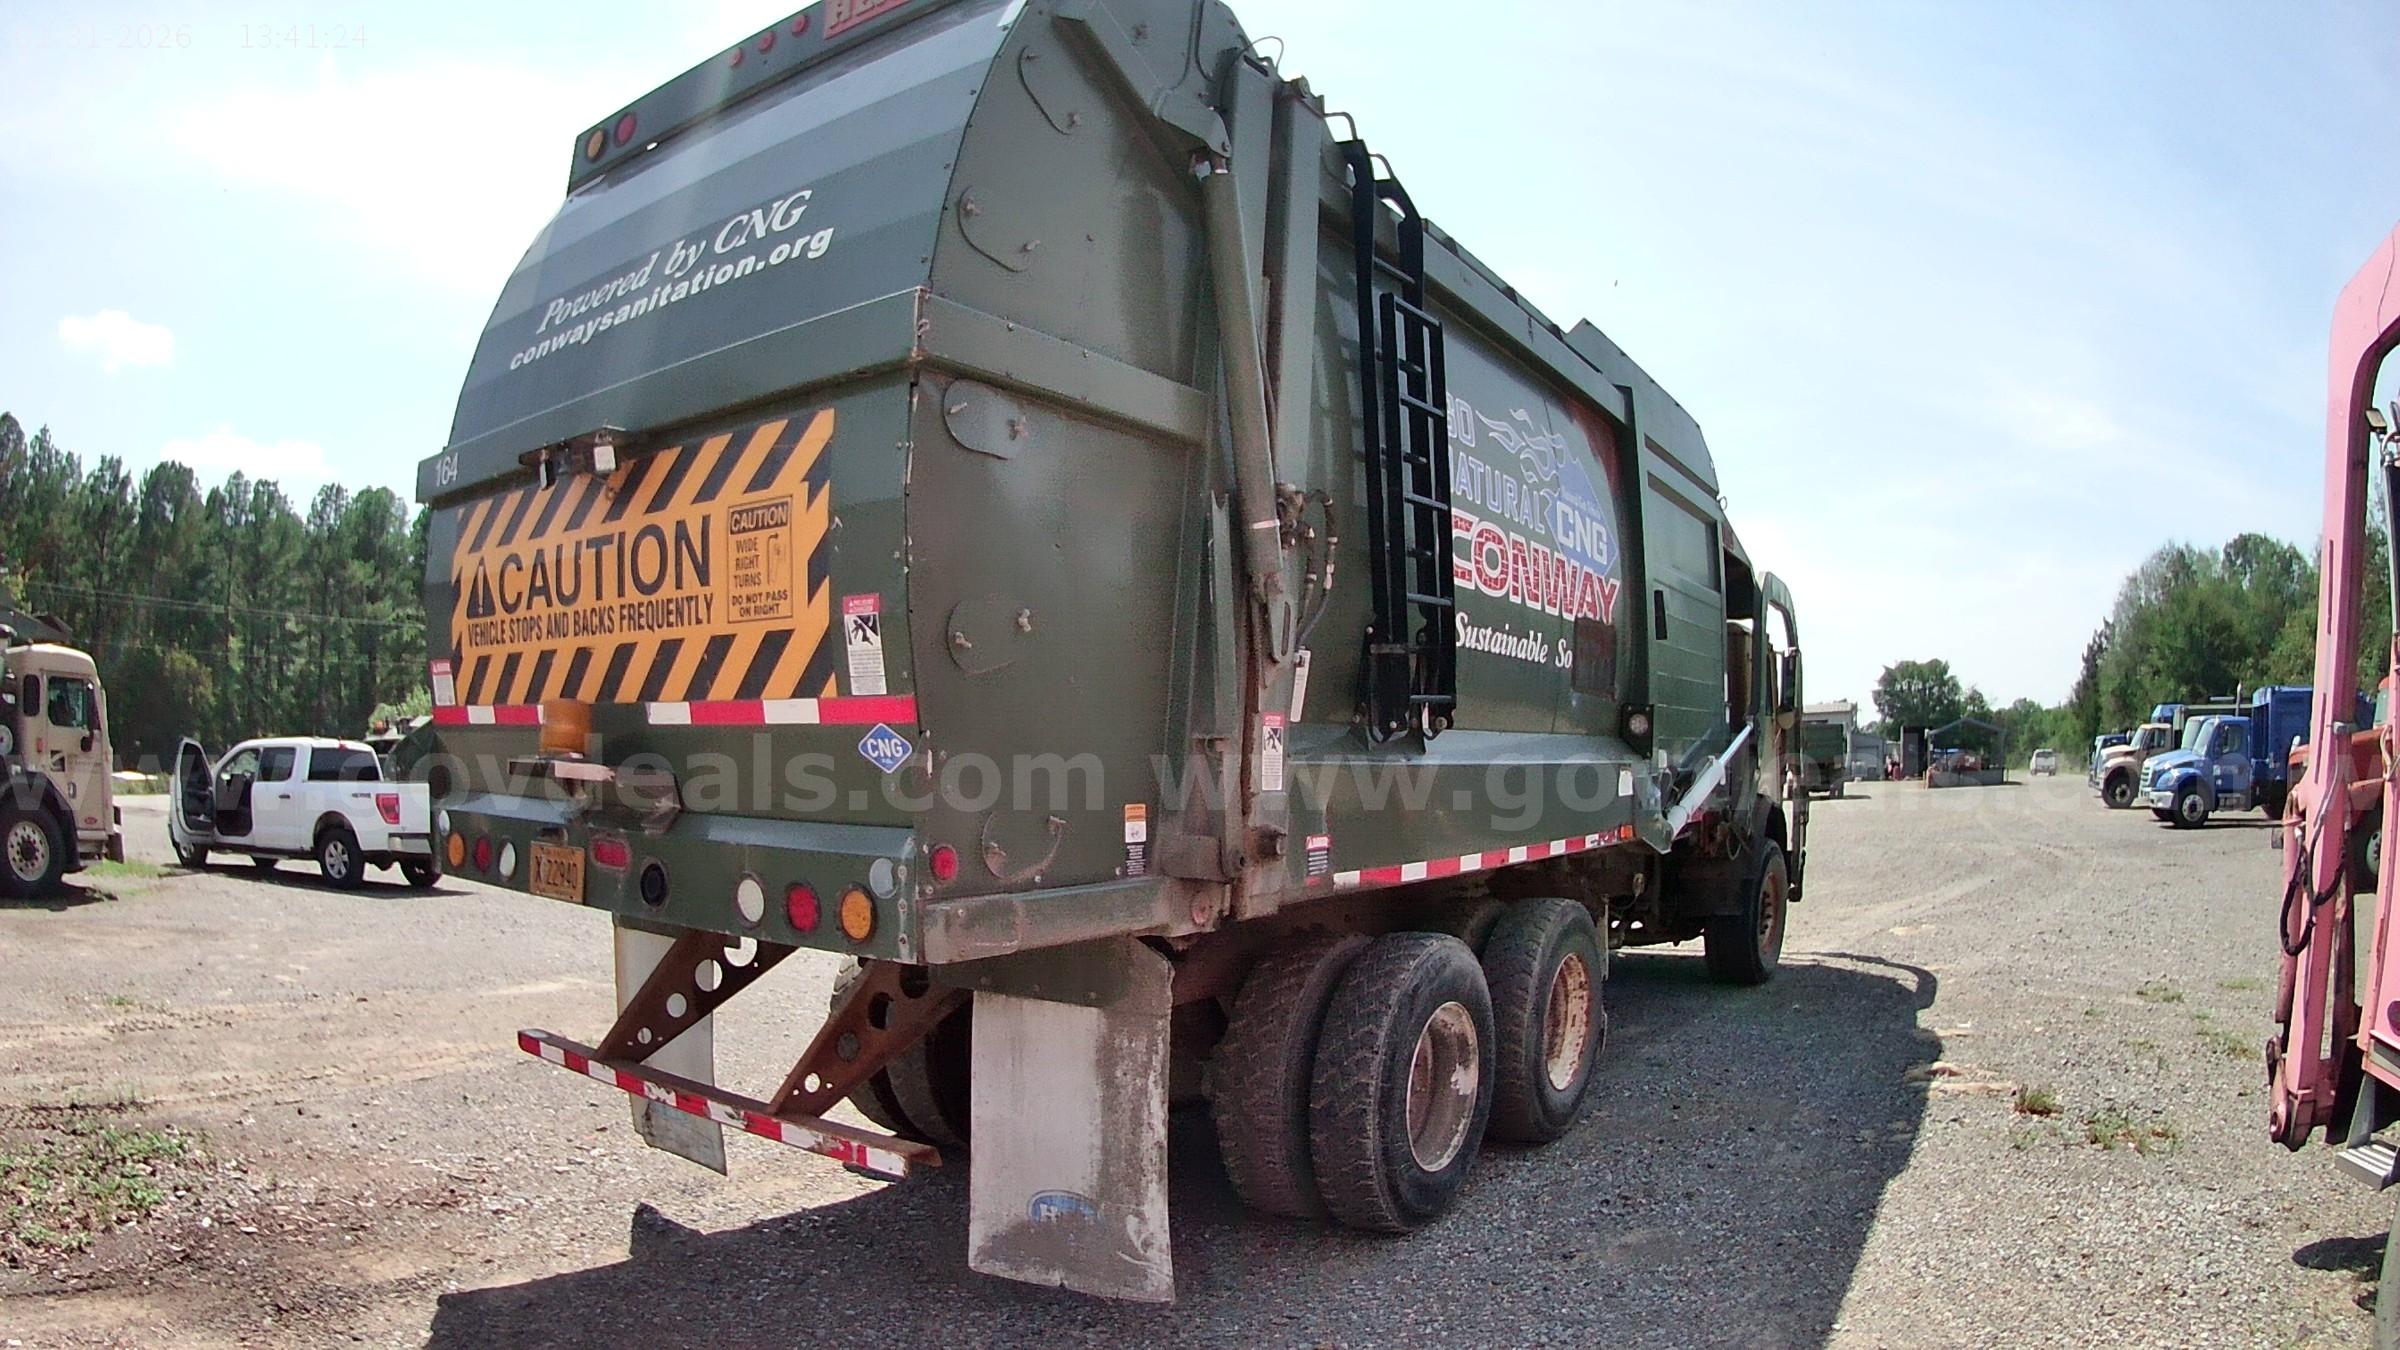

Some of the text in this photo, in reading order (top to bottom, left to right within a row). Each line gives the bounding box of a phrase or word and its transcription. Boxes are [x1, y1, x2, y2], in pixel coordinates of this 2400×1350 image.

[536, 190, 812, 334] Powered by CNG
[510, 227, 834, 370] conwaysanitation.org
[435, 452, 458, 487] 164
[1448, 445, 1545, 534] ATURAL
[731, 505, 787, 532] CAUTION
[1556, 500, 1607, 565] CNG
[498, 513, 712, 615] CAUTION
[735, 537, 758, 553] WIDE
[735, 554, 760, 571] RIGHT
[1451, 507, 1621, 626] CONWAY
[732, 589, 788, 606] DO NOT PASS
[733, 572, 761, 588] TURNS
[468, 593, 713, 648] VEHICLE STOPS AND BACKS FREQUENTLY
[740, 603, 780, 617] ON RIGHT
[1455, 611, 1548, 664] Sustainable
[867, 738, 903, 757] CNG
